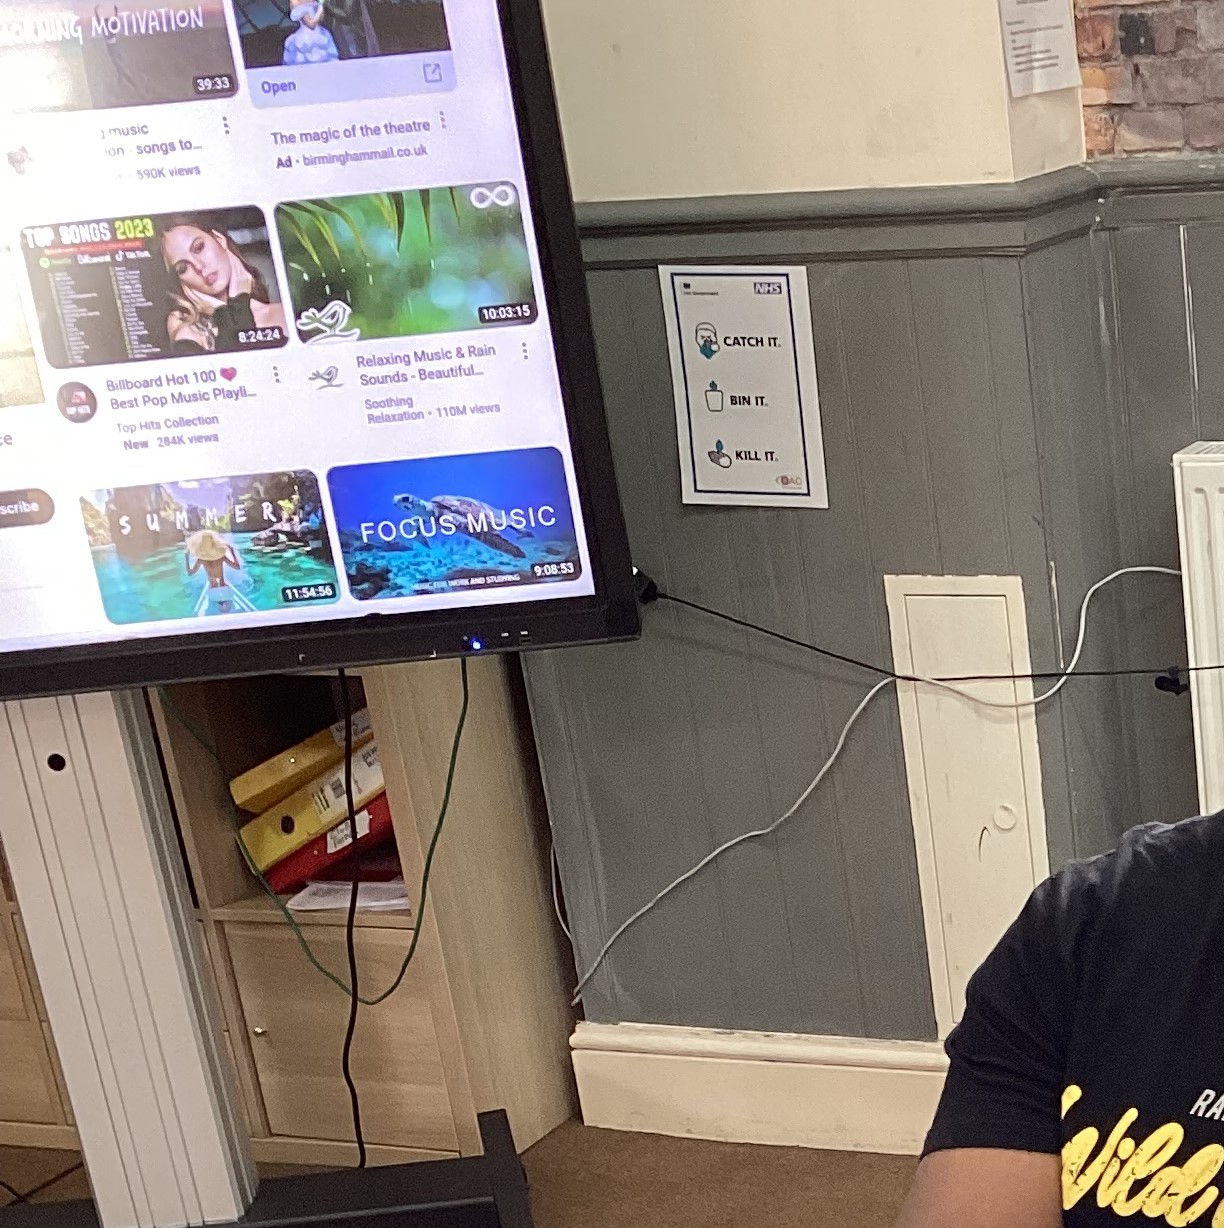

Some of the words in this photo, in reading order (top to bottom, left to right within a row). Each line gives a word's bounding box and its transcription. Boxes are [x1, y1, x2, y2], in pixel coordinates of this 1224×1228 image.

[91, 7, 205, 38] MOTIVATION
[196, 76, 231, 91] 39:33
[261, 80, 297, 96] Open
[108, 123, 150, 137] music
[270, 131, 297, 145] The
[299, 127, 341, 143] magic
[343, 124, 357, 139] of
[359, 123, 381, 138] the
[383, 120, 431, 136] theatre
[136, 141, 177, 156] songs
[276, 155, 293, 169] Ad
[302, 144, 429, 167] birminghammail.co.uk
[136, 167, 167, 180] 590K
[168, 165, 201, 177] views
[23, 226, 55, 249] TOP
[59, 222, 112, 245] SONGS
[114, 217, 155, 240] 2023
[755, 282, 782, 295] NHS
[482, 304, 532, 321] 10:03:15
[237, 328, 281, 343] 8:24:24
[723, 336, 765, 348] CATCH
[356, 352, 411, 368] Relaxing
[413, 348, 453, 363] Music
[456, 346, 465, 359] &
[467, 344, 497, 358] Rain
[106, 375, 163, 392] Billboard
[166, 373, 190, 387] Hot
[193, 369, 217, 383] 100
[359, 370, 409, 387] Sounds
[110, 397, 140, 410] Best
[142, 394, 168, 408] Pop
[171, 390, 211, 404] Music
[364, 396, 414, 411] Soothing
[729, 395, 751, 406] BIN
[367, 409, 425, 425] Relaxation
[436, 404, 468, 418] 110M
[469, 402, 501, 415] views
[117, 422, 137, 434] Top
[139, 419, 162, 431] Hits
[164, 415, 220, 429] Collection
[123, 439, 149, 451] New
[187, 432, 220, 444] views
[735, 450, 762, 462] KILL
[118, 500, 279, 535] SUMMER
[360, 515, 458, 544] FOCUS
[467, 504, 557, 534] MUSIC
[533, 561, 575, 577] 9:08:53
[285, 585, 333, 600] 11:54:56
